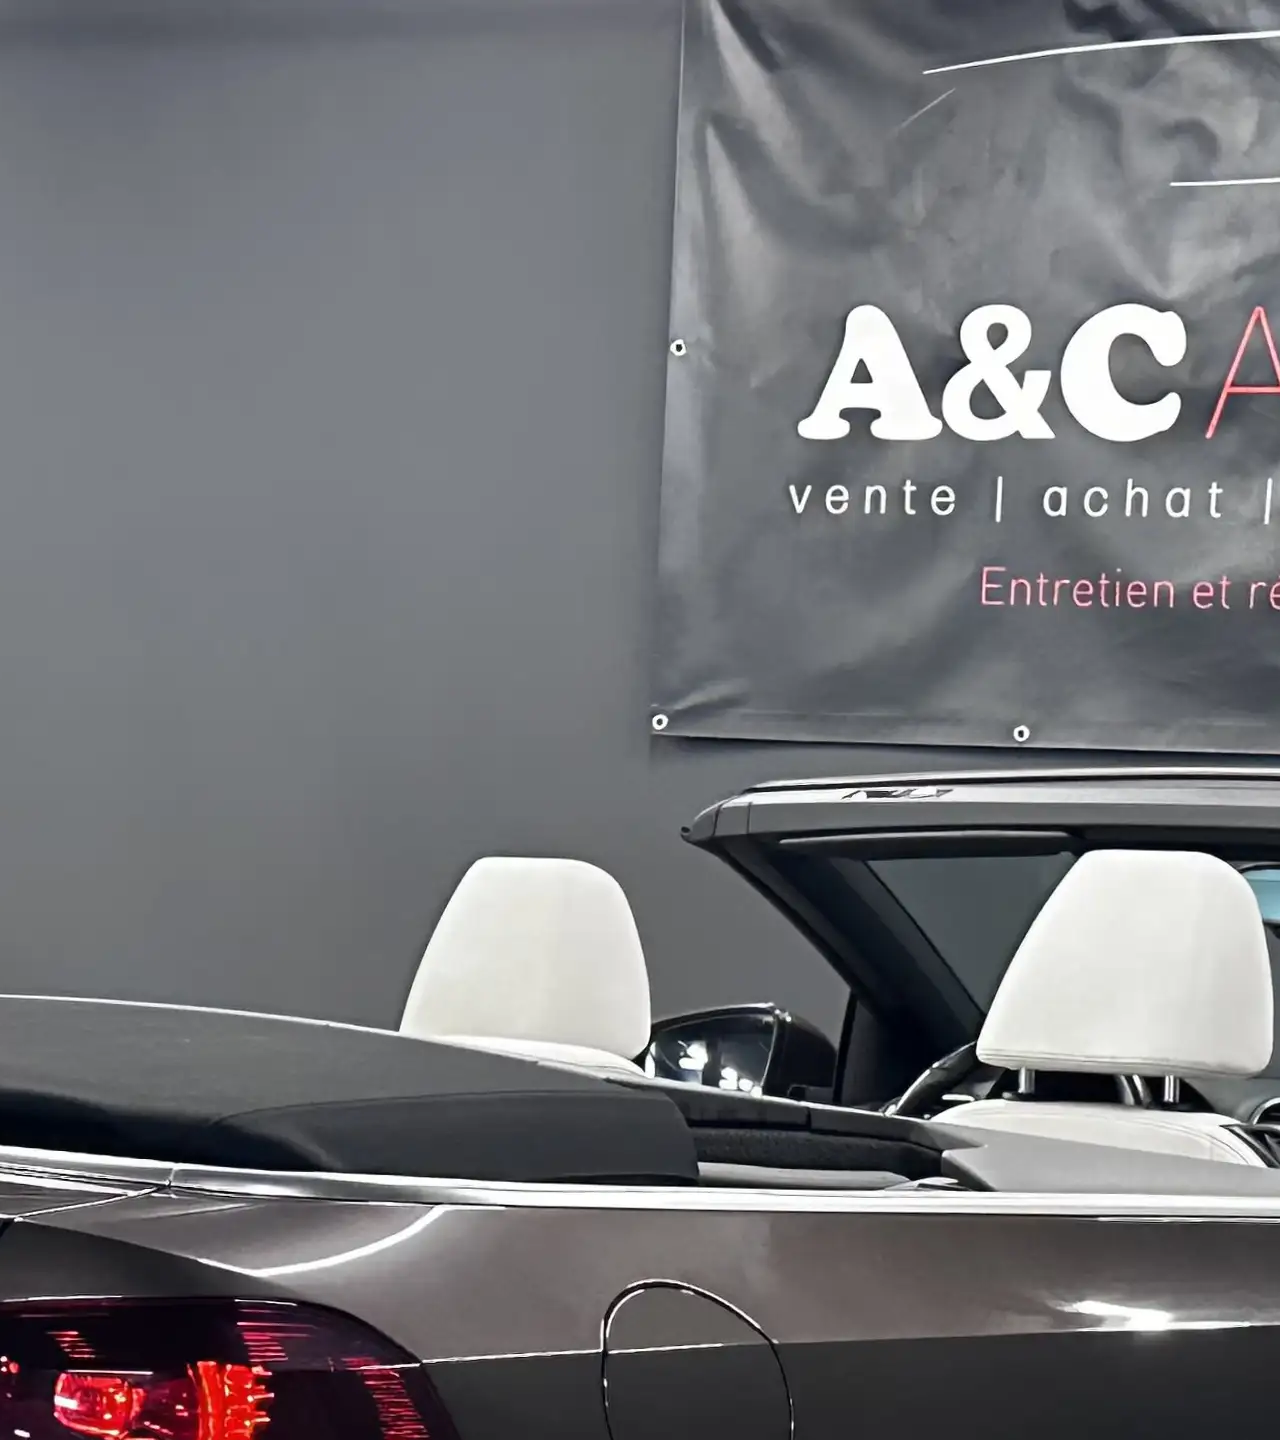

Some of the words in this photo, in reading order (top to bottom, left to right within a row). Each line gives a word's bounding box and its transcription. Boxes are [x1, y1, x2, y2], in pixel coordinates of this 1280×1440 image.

[797, 303, 1187, 442] A&C
[788, 479, 956, 516] vente
[1042, 478, 1224, 519] achat
[980, 566, 1175, 609] Entretien
[1191, 574, 1231, 610] et
